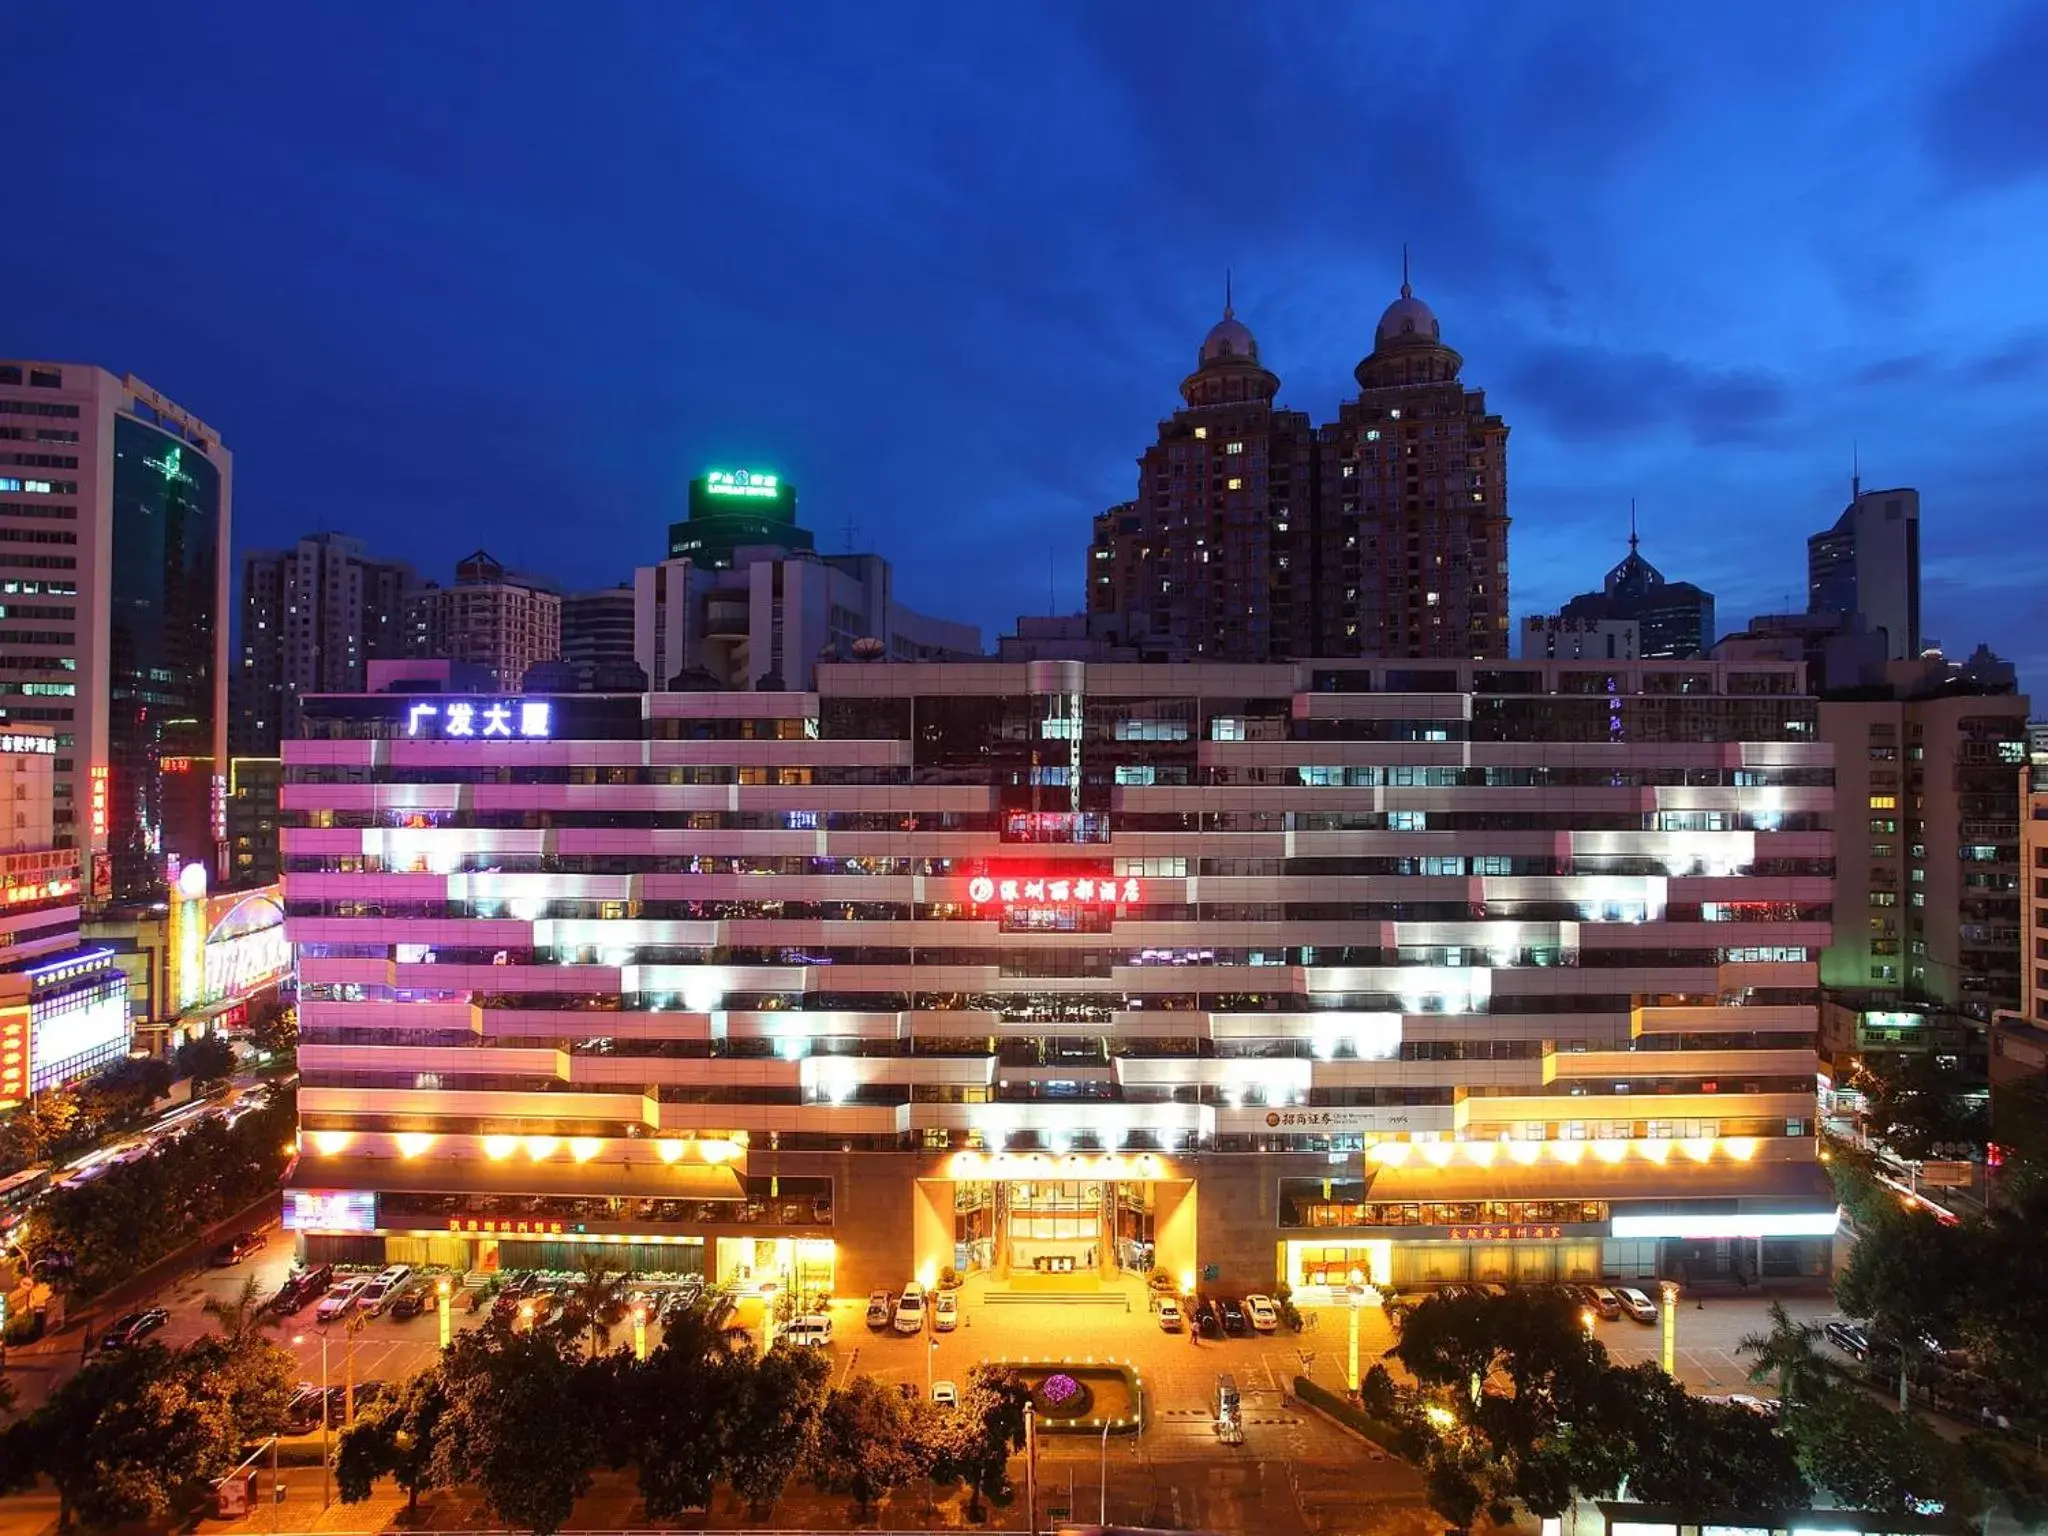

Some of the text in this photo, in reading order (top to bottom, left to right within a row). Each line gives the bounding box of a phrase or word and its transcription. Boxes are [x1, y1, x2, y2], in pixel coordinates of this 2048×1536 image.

[408, 703, 550, 736] 广发大厦
[999, 878, 1140, 902] 深圳丽都酒店
[1282, 1113, 1333, 1126] 招商证券
